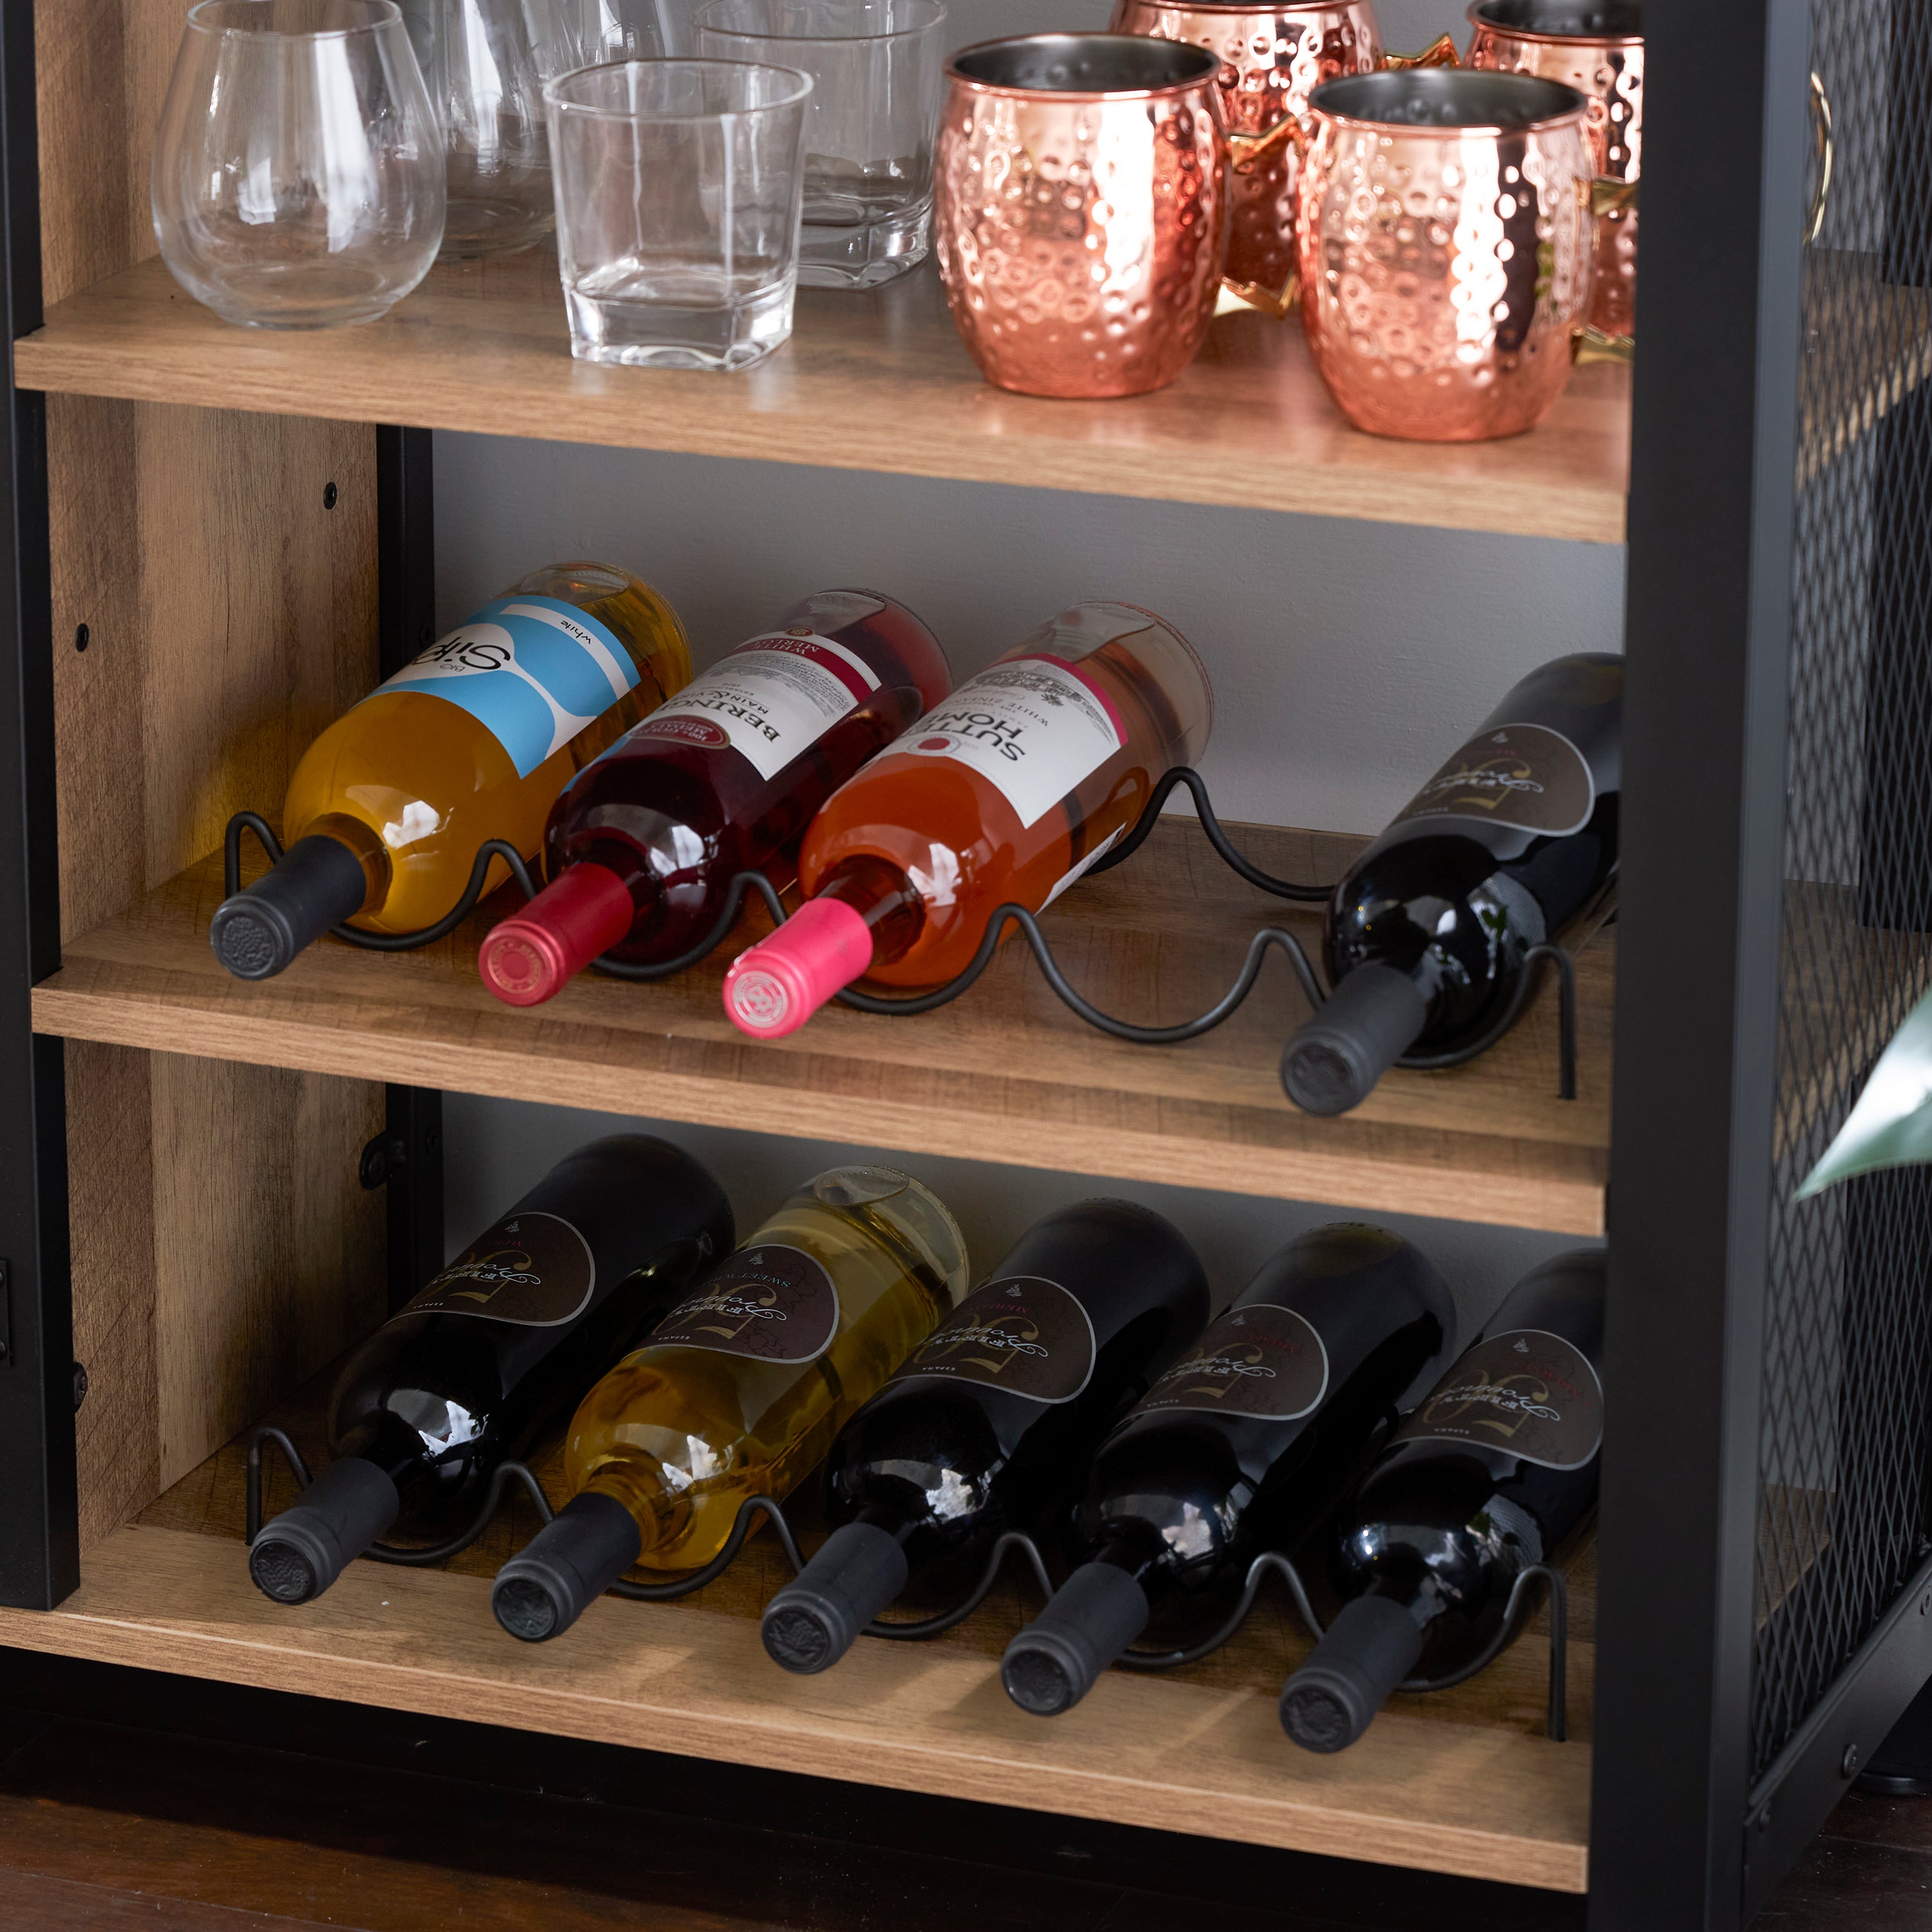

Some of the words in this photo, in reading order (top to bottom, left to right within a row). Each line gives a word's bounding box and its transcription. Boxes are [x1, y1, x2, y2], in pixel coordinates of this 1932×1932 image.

[560, 620, 591, 644] white
[755, 644, 805, 654] WHITE
[440, 663, 465, 672] BIO
[730, 695, 768, 714] MAIN
[661, 699, 781, 742] BERING
[739, 1273, 790, 1288] SWEET
